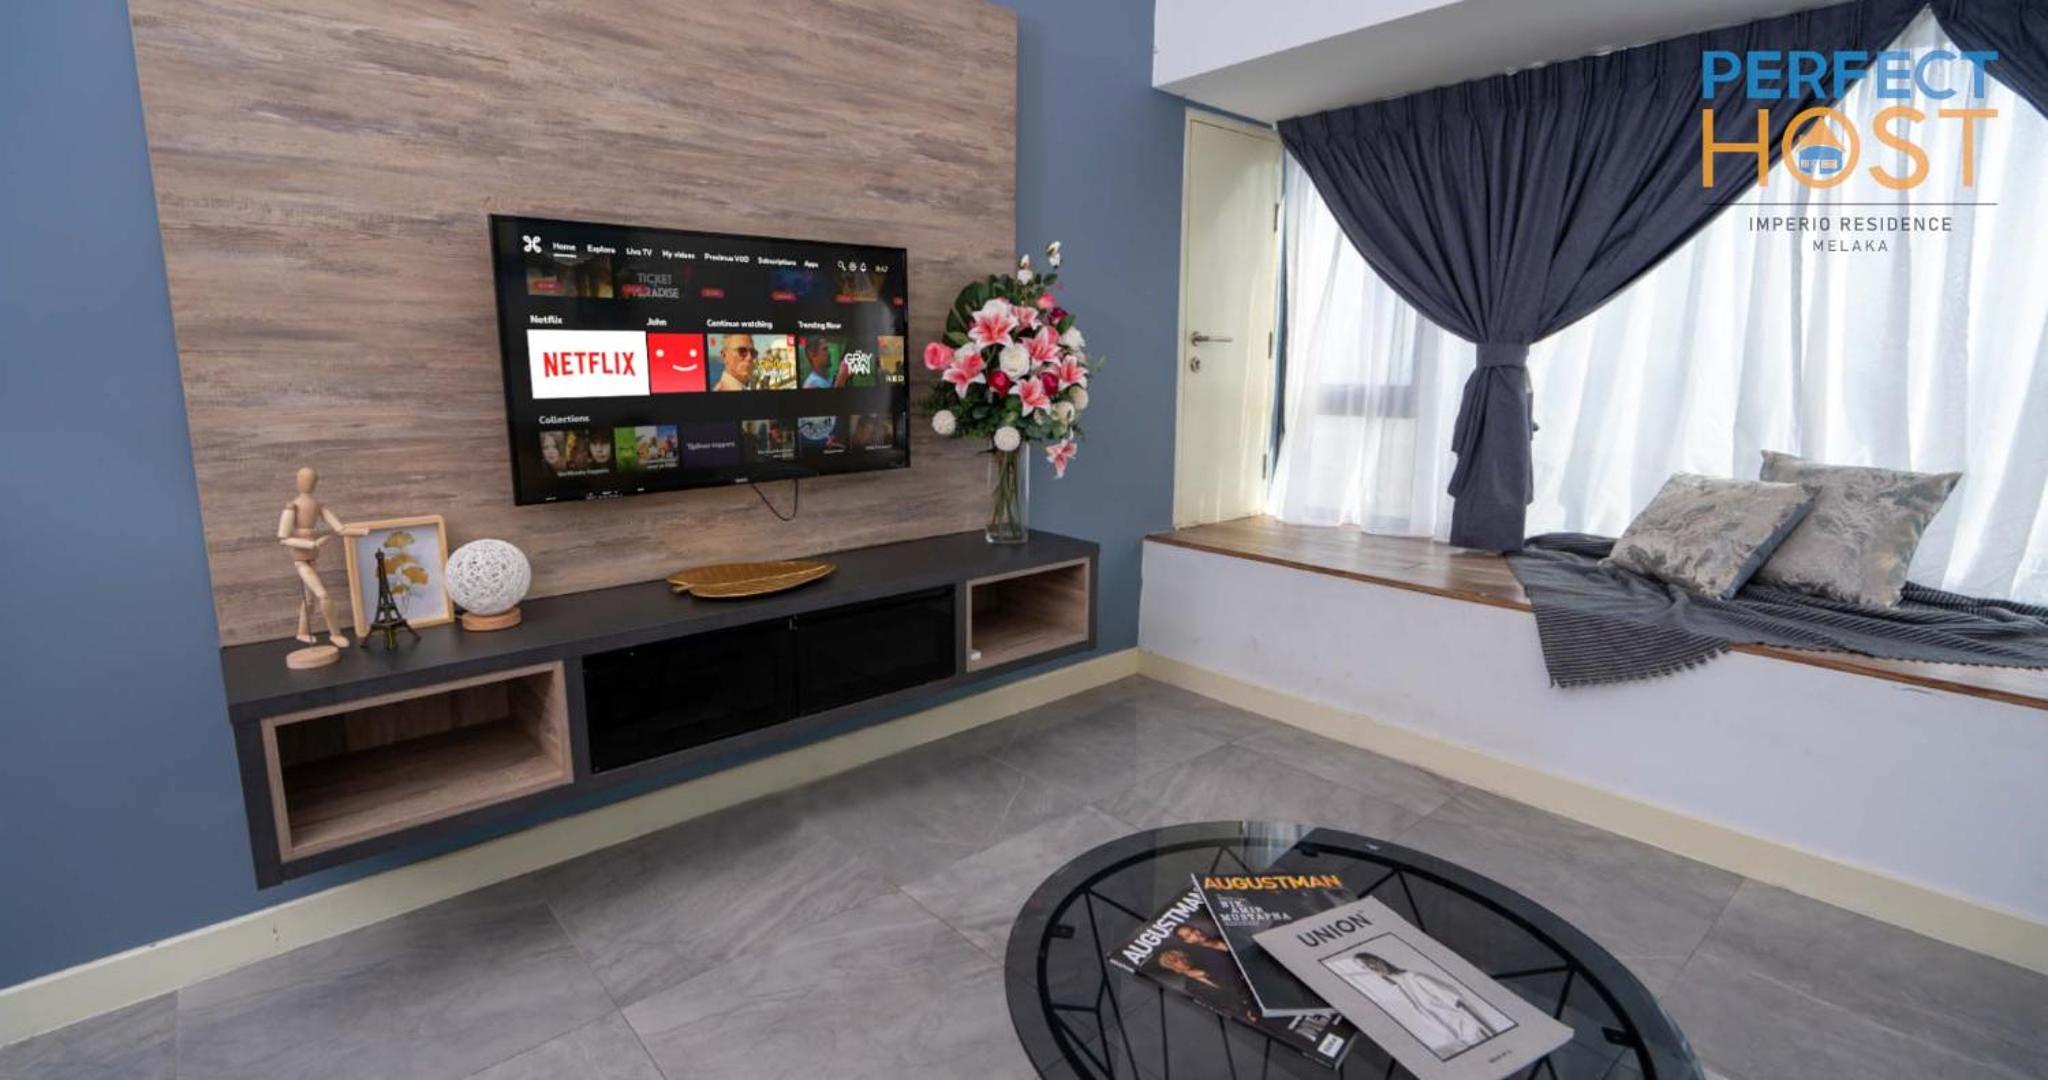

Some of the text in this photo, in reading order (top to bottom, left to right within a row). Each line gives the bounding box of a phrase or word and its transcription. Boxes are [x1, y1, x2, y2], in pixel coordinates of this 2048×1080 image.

[552, 242, 576, 251] Home
[586, 243, 617, 255] Explore
[626, 247, 653, 257] Live TV
[661, 249, 696, 260] My videos
[757, 256, 797, 267] Subscriptions
[804, 259, 819, 269] Apps
[636, 271, 672, 285] TICKET
[529, 314, 563, 325] Netflix
[646, 318, 668, 327] John
[706, 318, 774, 330] Continue watching
[797, 320, 842, 331] Trending Now
[543, 351, 636, 378] NETFLIX
[848, 361, 871, 375] MAN
[538, 414, 591, 425] Collections
[1203, 875, 1342, 891] AUGUSTMAN
[1297, 913, 1373, 947] UNION
